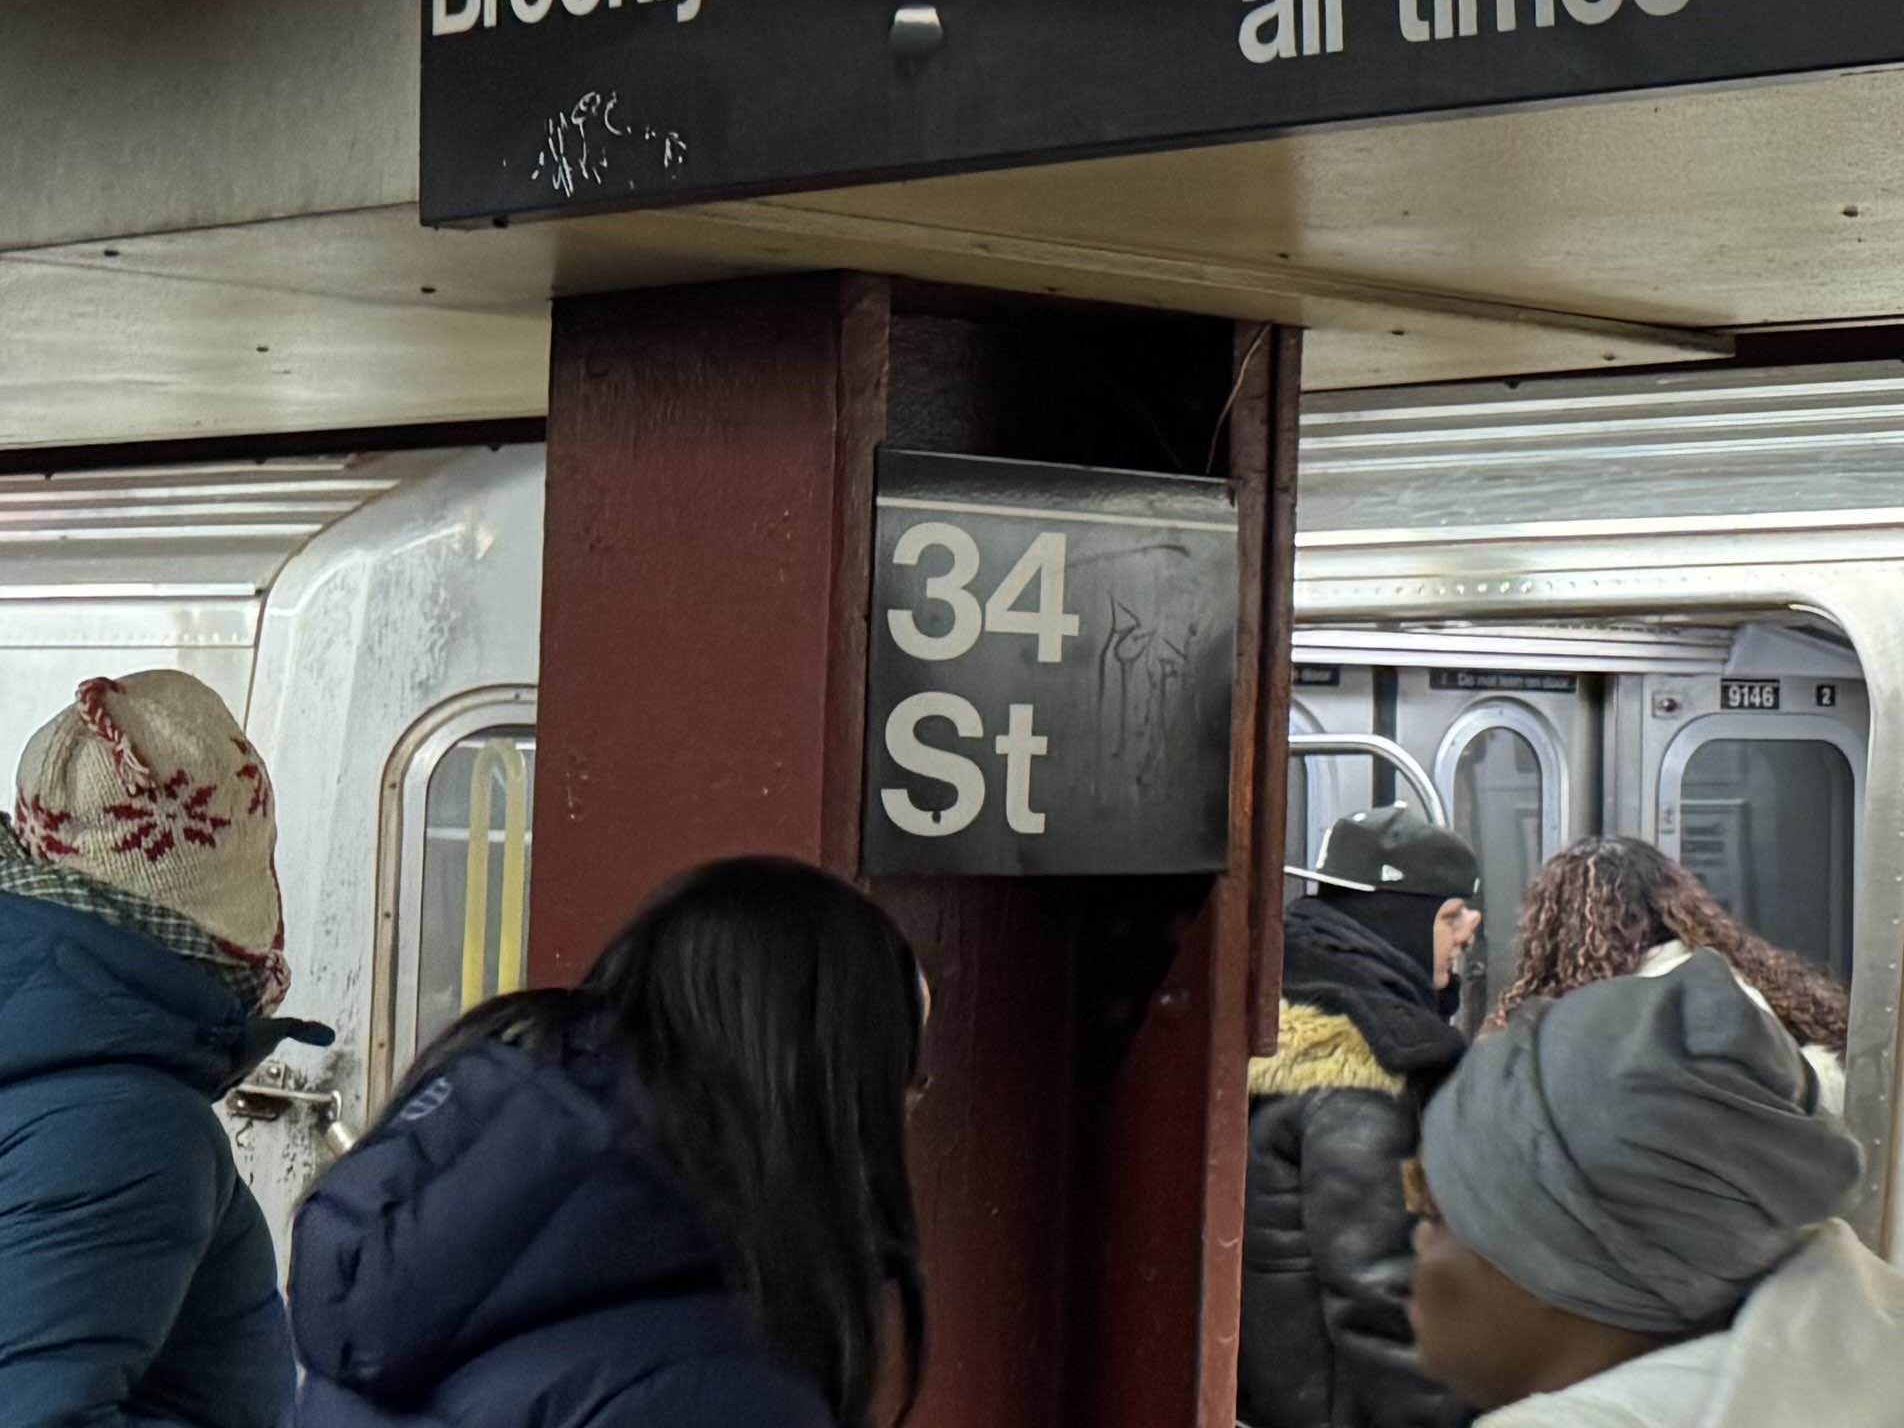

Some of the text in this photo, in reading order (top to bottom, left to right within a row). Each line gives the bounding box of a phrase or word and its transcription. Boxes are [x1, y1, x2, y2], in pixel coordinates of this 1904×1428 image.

[887, 522, 1079, 663] 34
[1729, 685, 1774, 708] 9146
[1821, 688, 1832, 705] 2
[881, 691, 1048, 836] St
